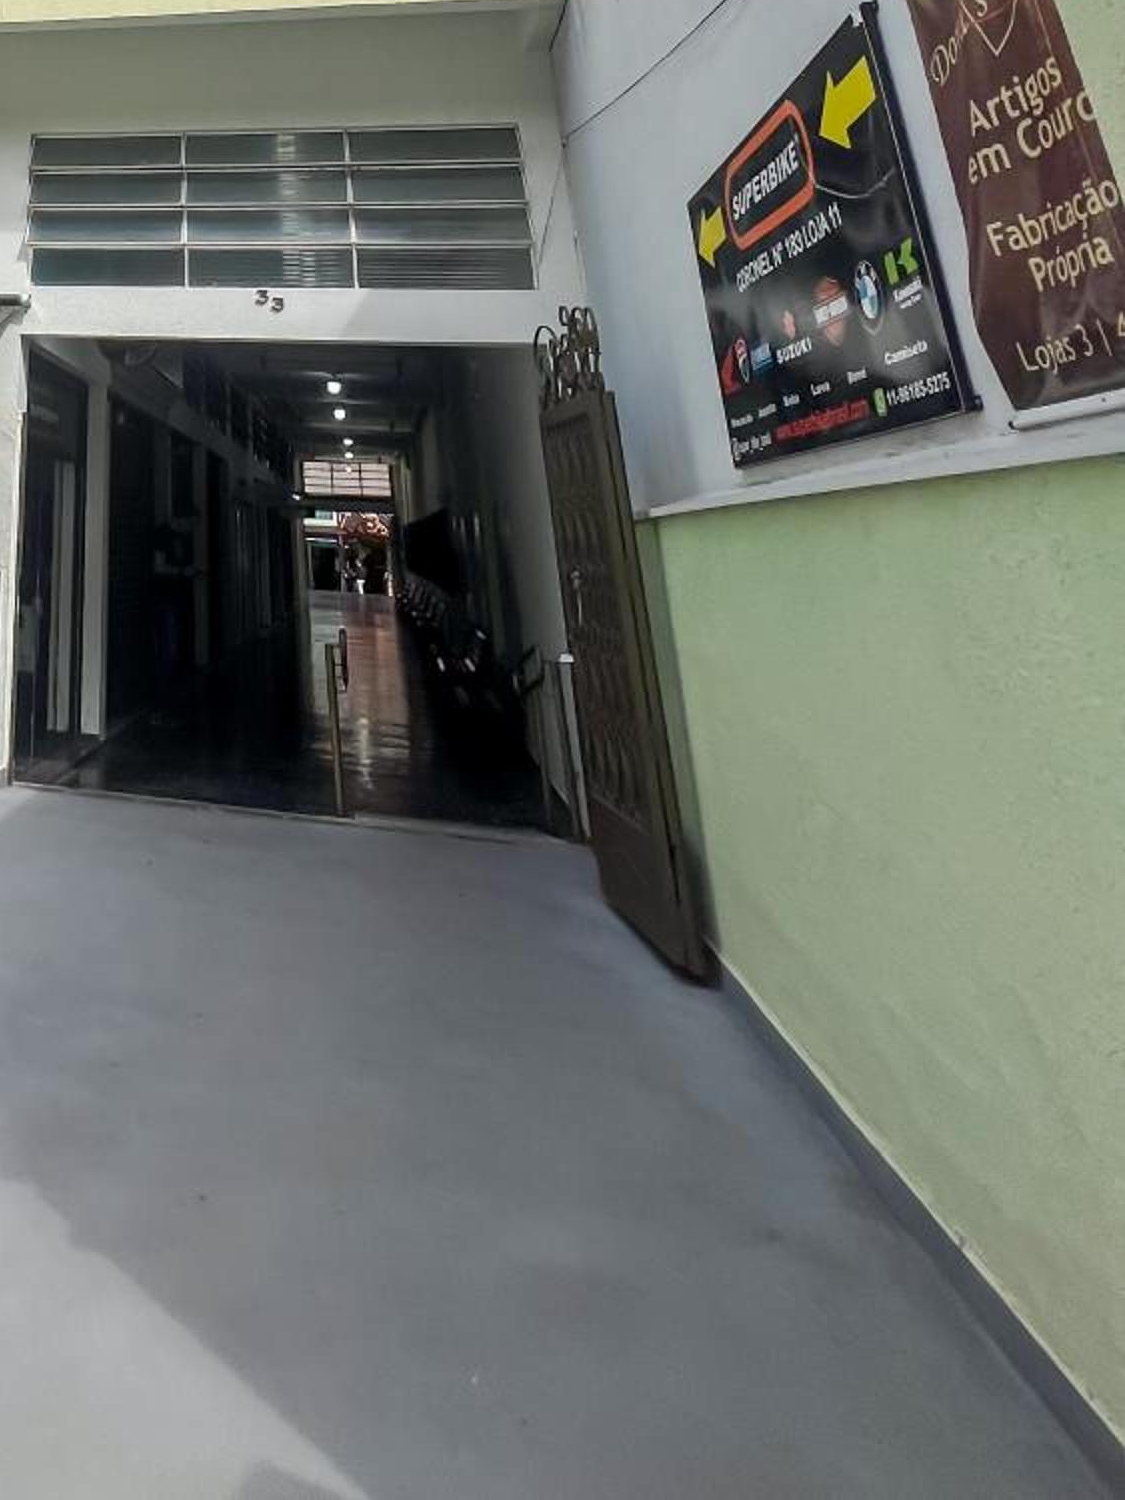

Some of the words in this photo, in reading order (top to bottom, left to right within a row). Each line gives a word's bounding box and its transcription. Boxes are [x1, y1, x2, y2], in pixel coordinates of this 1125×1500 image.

[969, 56, 1063, 138] Artigos
[731, 139, 800, 221] SUPERBIKE
[968, 141, 1012, 185] em
[801, 211, 832, 249] LOJA
[828, 201, 842, 229] 11
[986, 176, 1119, 257] Fabricação
[1028, 231, 1115, 292] Própria
[776, 336, 813, 365] SUZUKI
[1016, 335, 1076, 375] Lojas
[1075, 323, 1094, 357] 3
